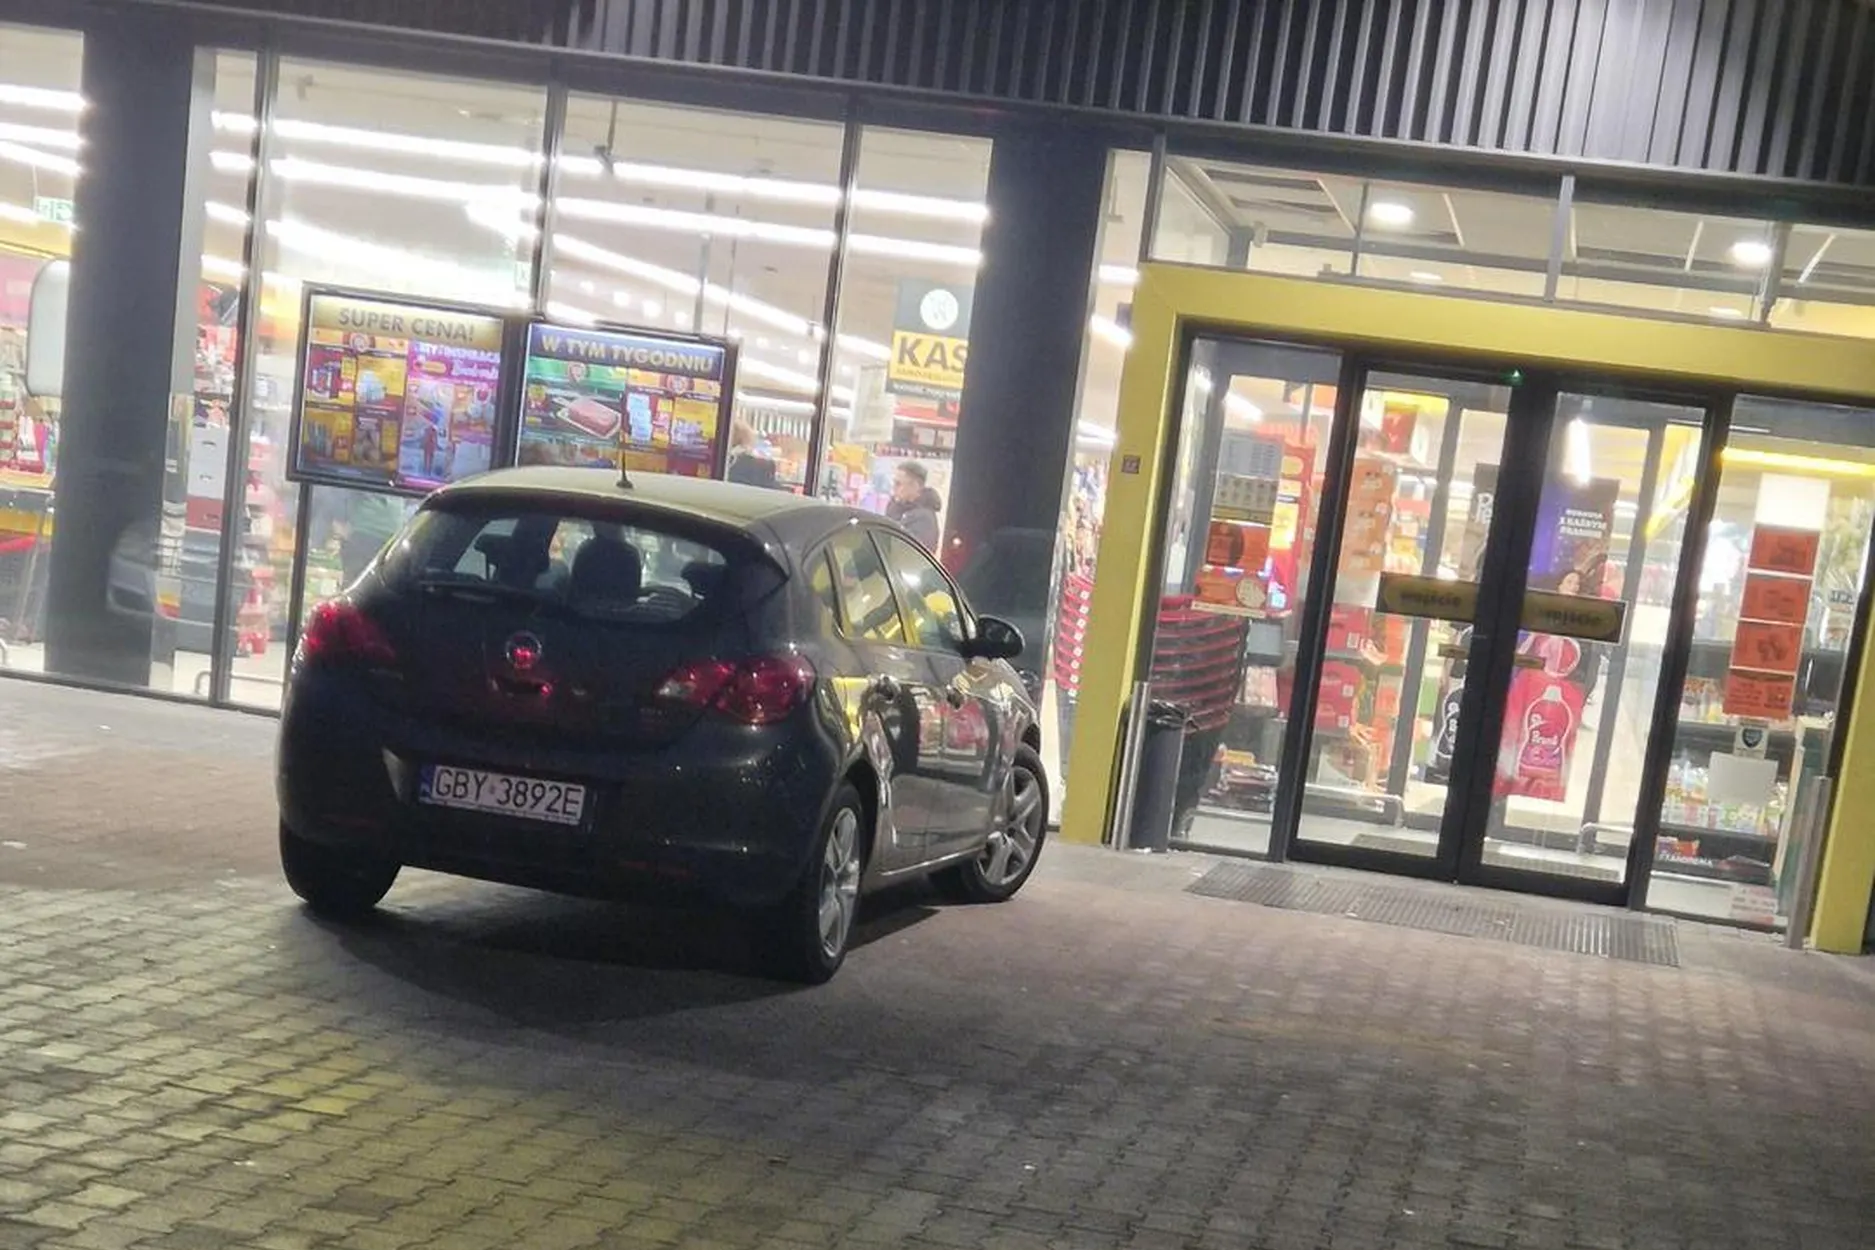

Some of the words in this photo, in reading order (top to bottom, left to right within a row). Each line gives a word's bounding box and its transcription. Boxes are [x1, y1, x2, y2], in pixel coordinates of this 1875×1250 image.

[339, 308, 404, 332] SUPER
[411, 317, 475, 342] CENA!
[541, 334, 562, 352] W
[566, 338, 606, 358] TYM
[611, 345, 714, 373] TYGODNIU
[434, 768, 489, 801] GBY
[496, 777, 583, 816] 3892E
